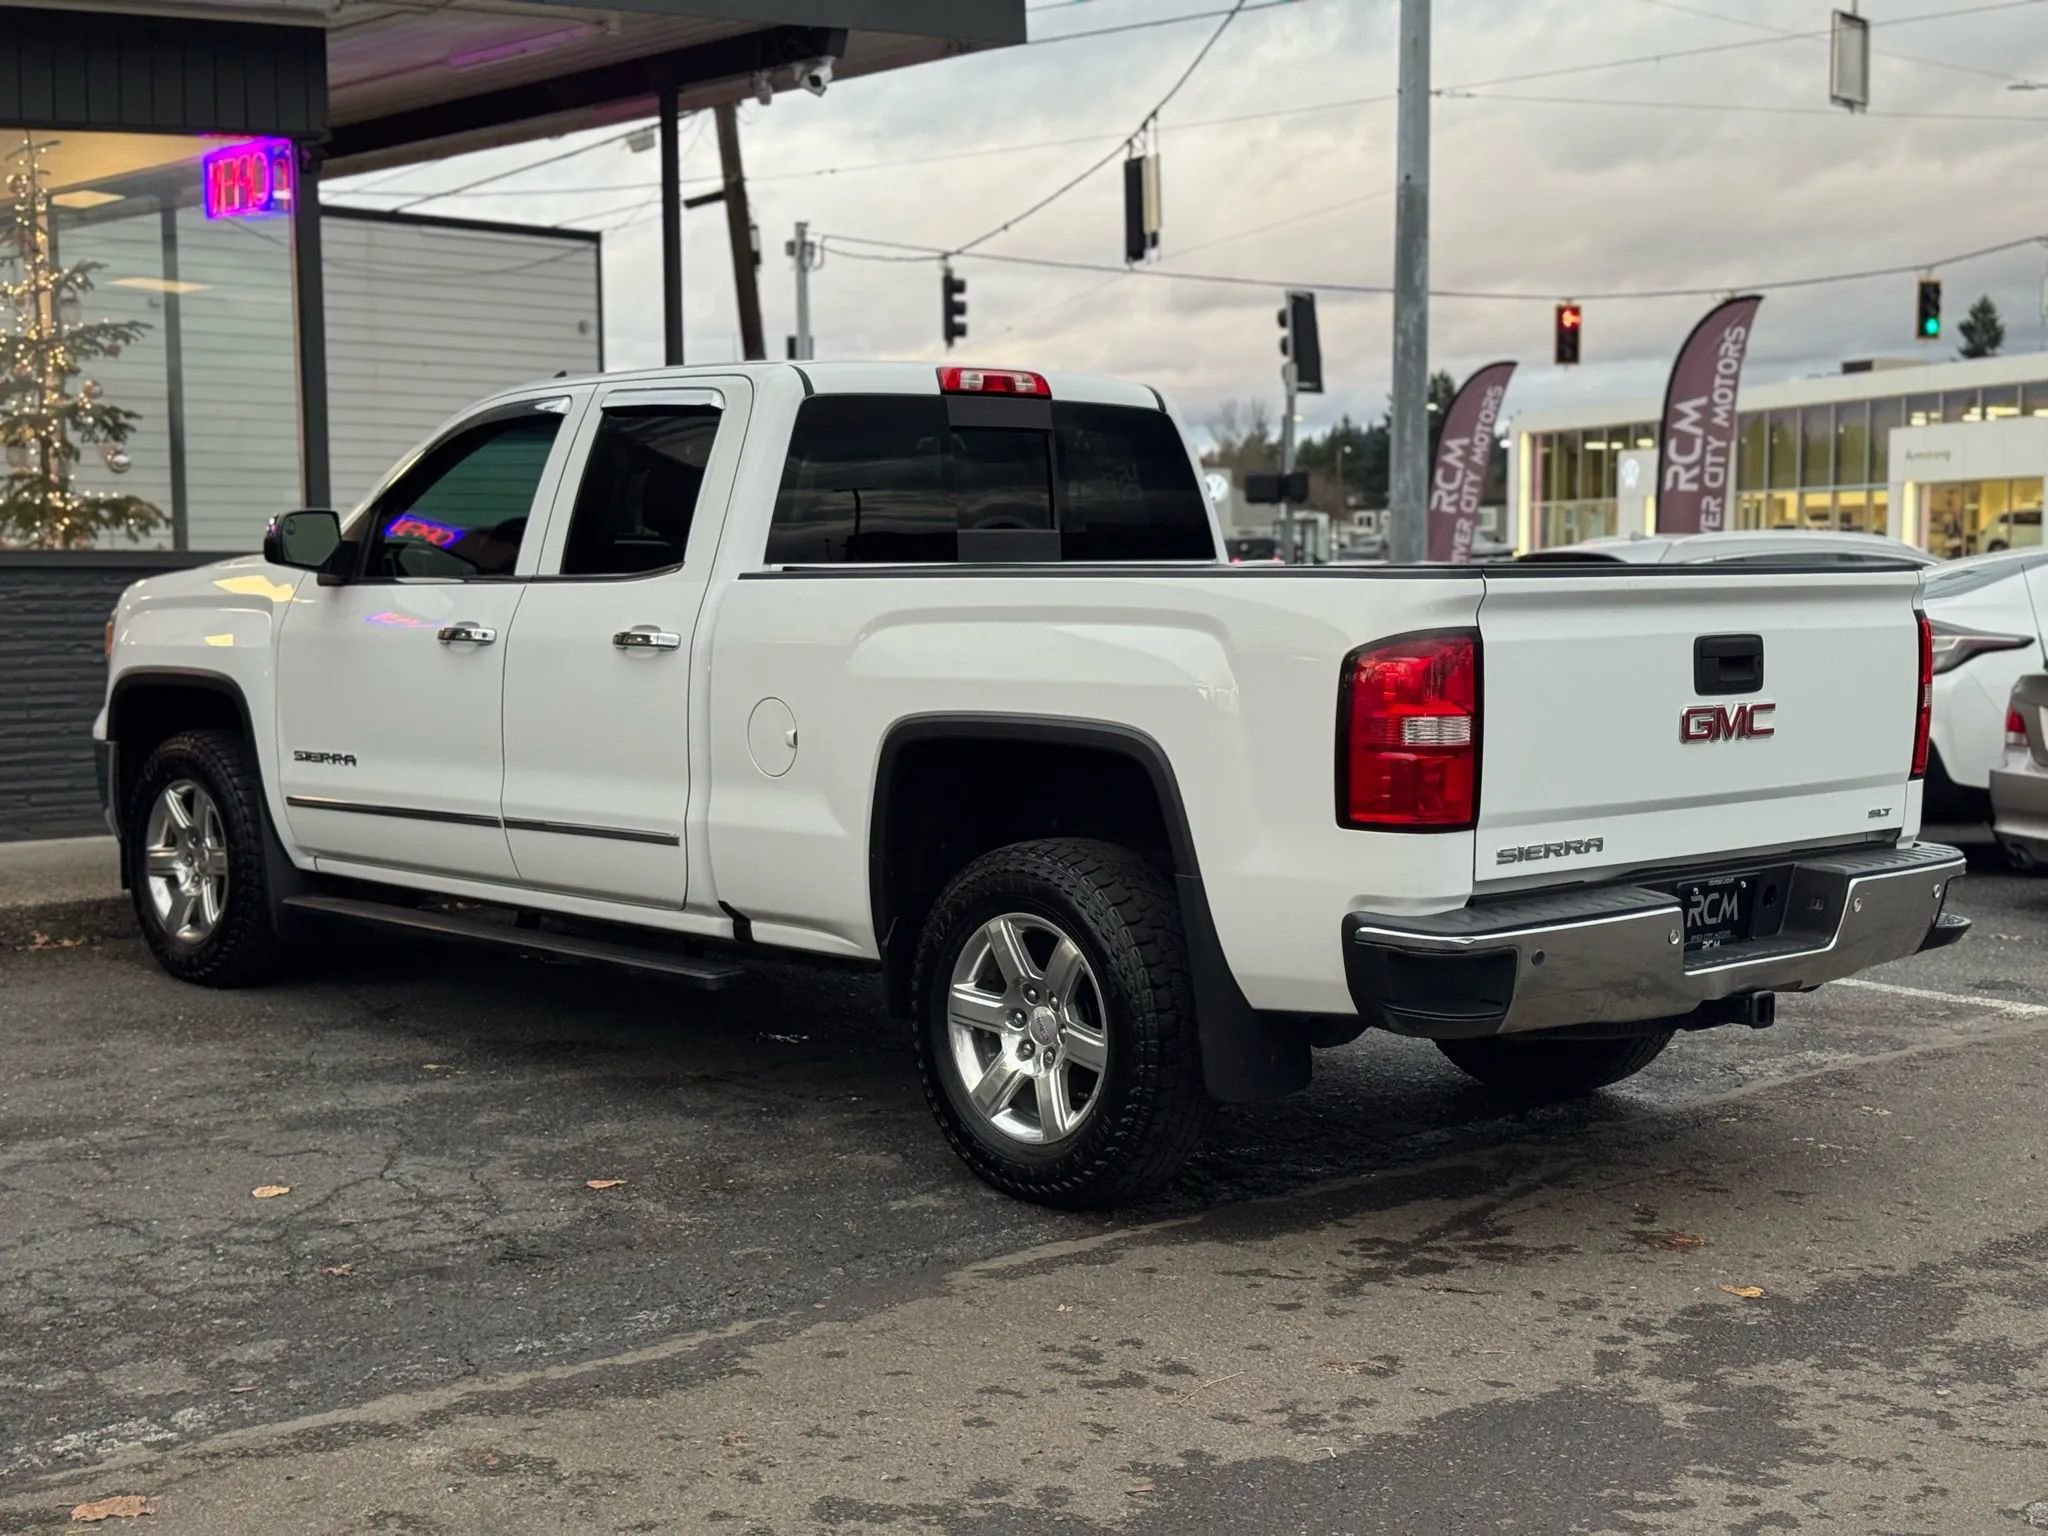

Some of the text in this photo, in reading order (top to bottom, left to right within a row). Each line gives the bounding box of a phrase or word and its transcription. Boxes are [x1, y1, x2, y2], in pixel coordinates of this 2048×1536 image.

[1711, 325, 1746, 428] MOTORS
[1469, 384, 1504, 466] MOTORS
[1665, 396, 1709, 492] RCM
[1430, 436, 1471, 514] RCM
[1704, 435, 1727, 489] CITY
[1459, 469, 1483, 513] CITY
[1679, 702, 1777, 744] GMC
[294, 750, 357, 768] SIERRA
[1867, 807, 1893, 819] SLT
[1496, 836, 1604, 866] SIERRA
[1686, 890, 1739, 928] RCM
